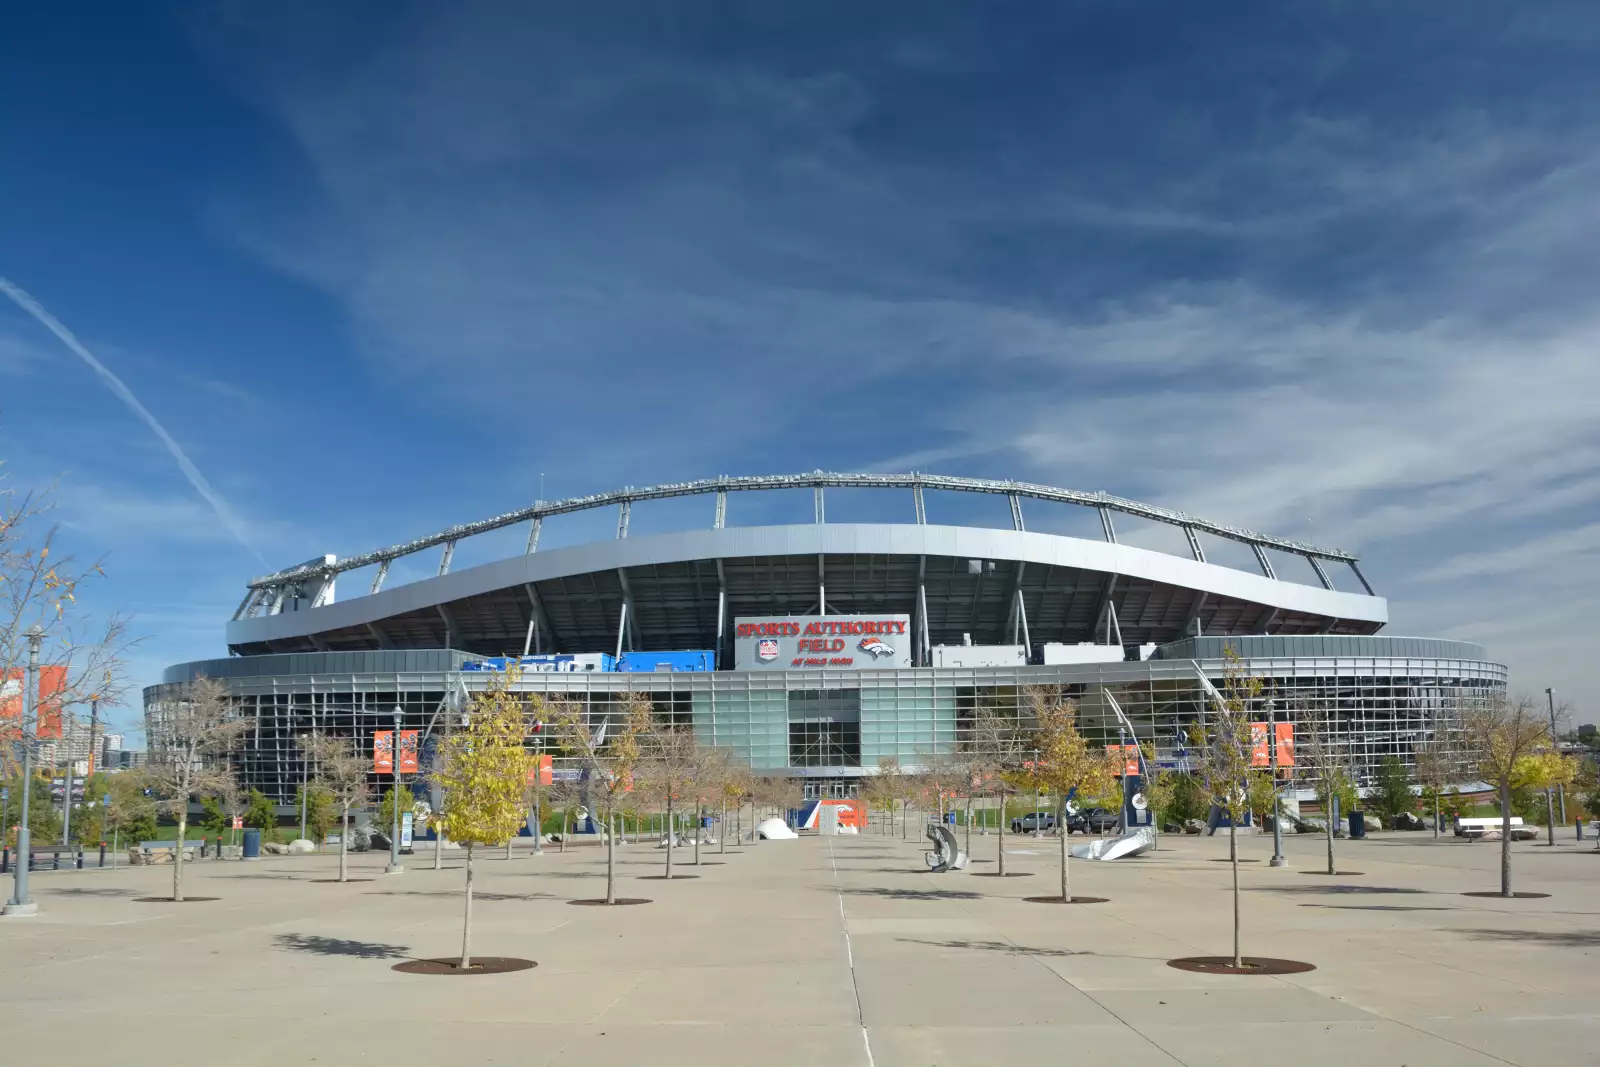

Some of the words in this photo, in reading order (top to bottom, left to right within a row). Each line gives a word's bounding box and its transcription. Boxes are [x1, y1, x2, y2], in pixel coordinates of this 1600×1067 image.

[737, 622, 800, 636] SPORTS
[803, 620, 907, 635] AUTHORITY
[799, 638, 846, 653] FIELD
